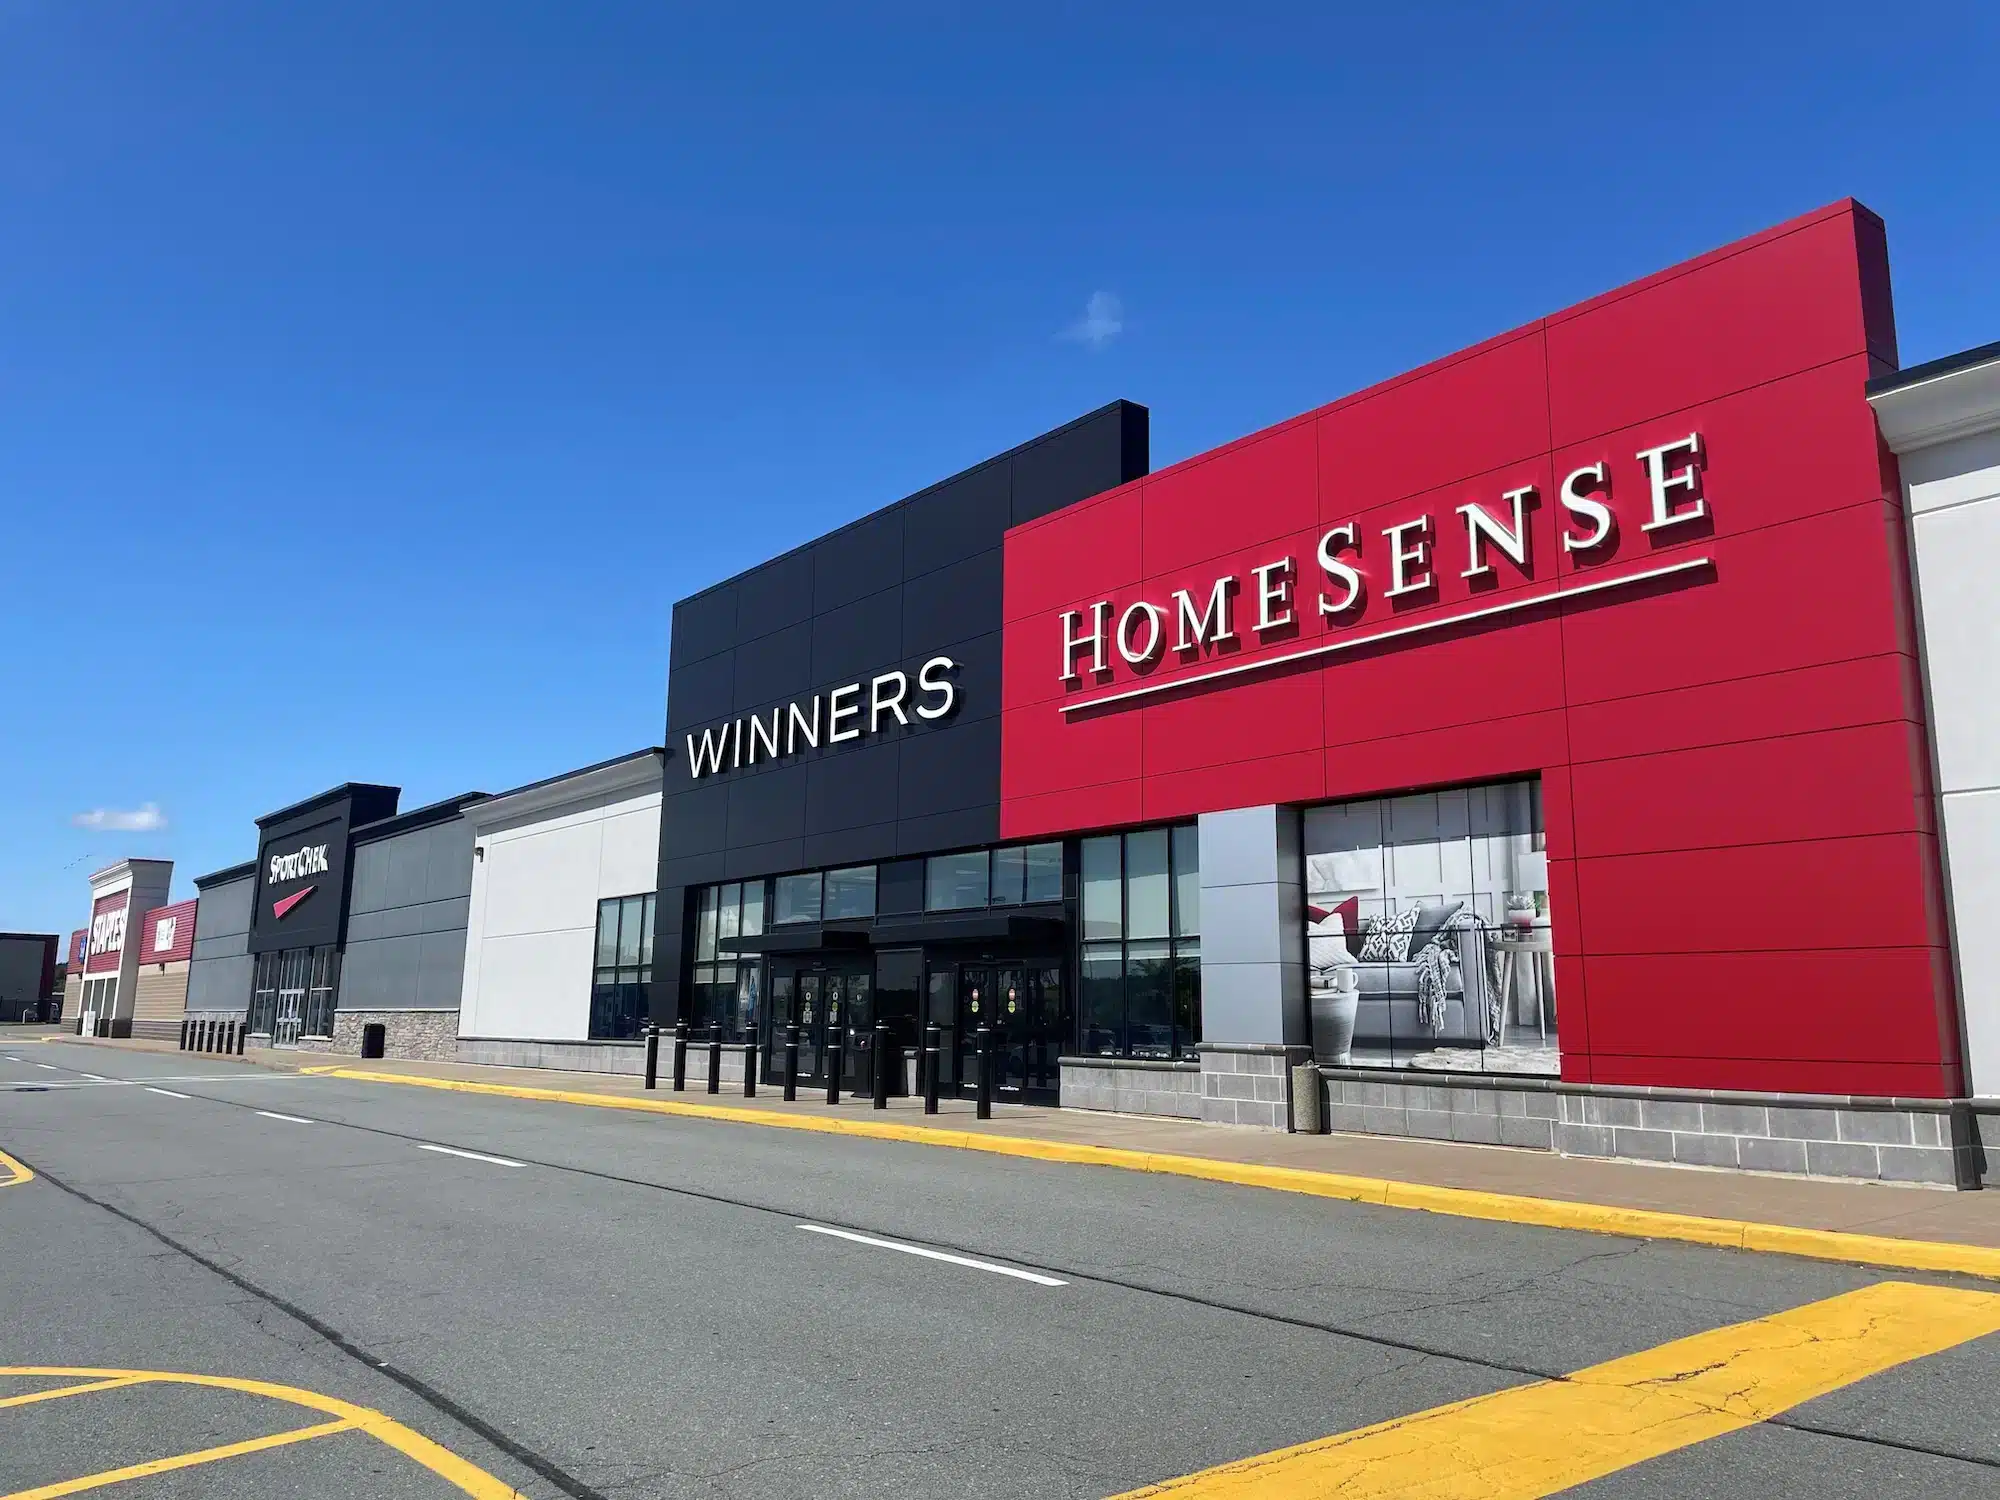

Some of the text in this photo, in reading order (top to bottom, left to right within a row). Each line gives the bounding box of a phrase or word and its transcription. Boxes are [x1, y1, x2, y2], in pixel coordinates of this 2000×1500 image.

[1058, 431, 1706, 681] HOMESENSE
[686, 656, 954, 779] WINNERS
[268, 844, 329, 885] SPORTCHEK
[91, 907, 127, 956] STAPLES
